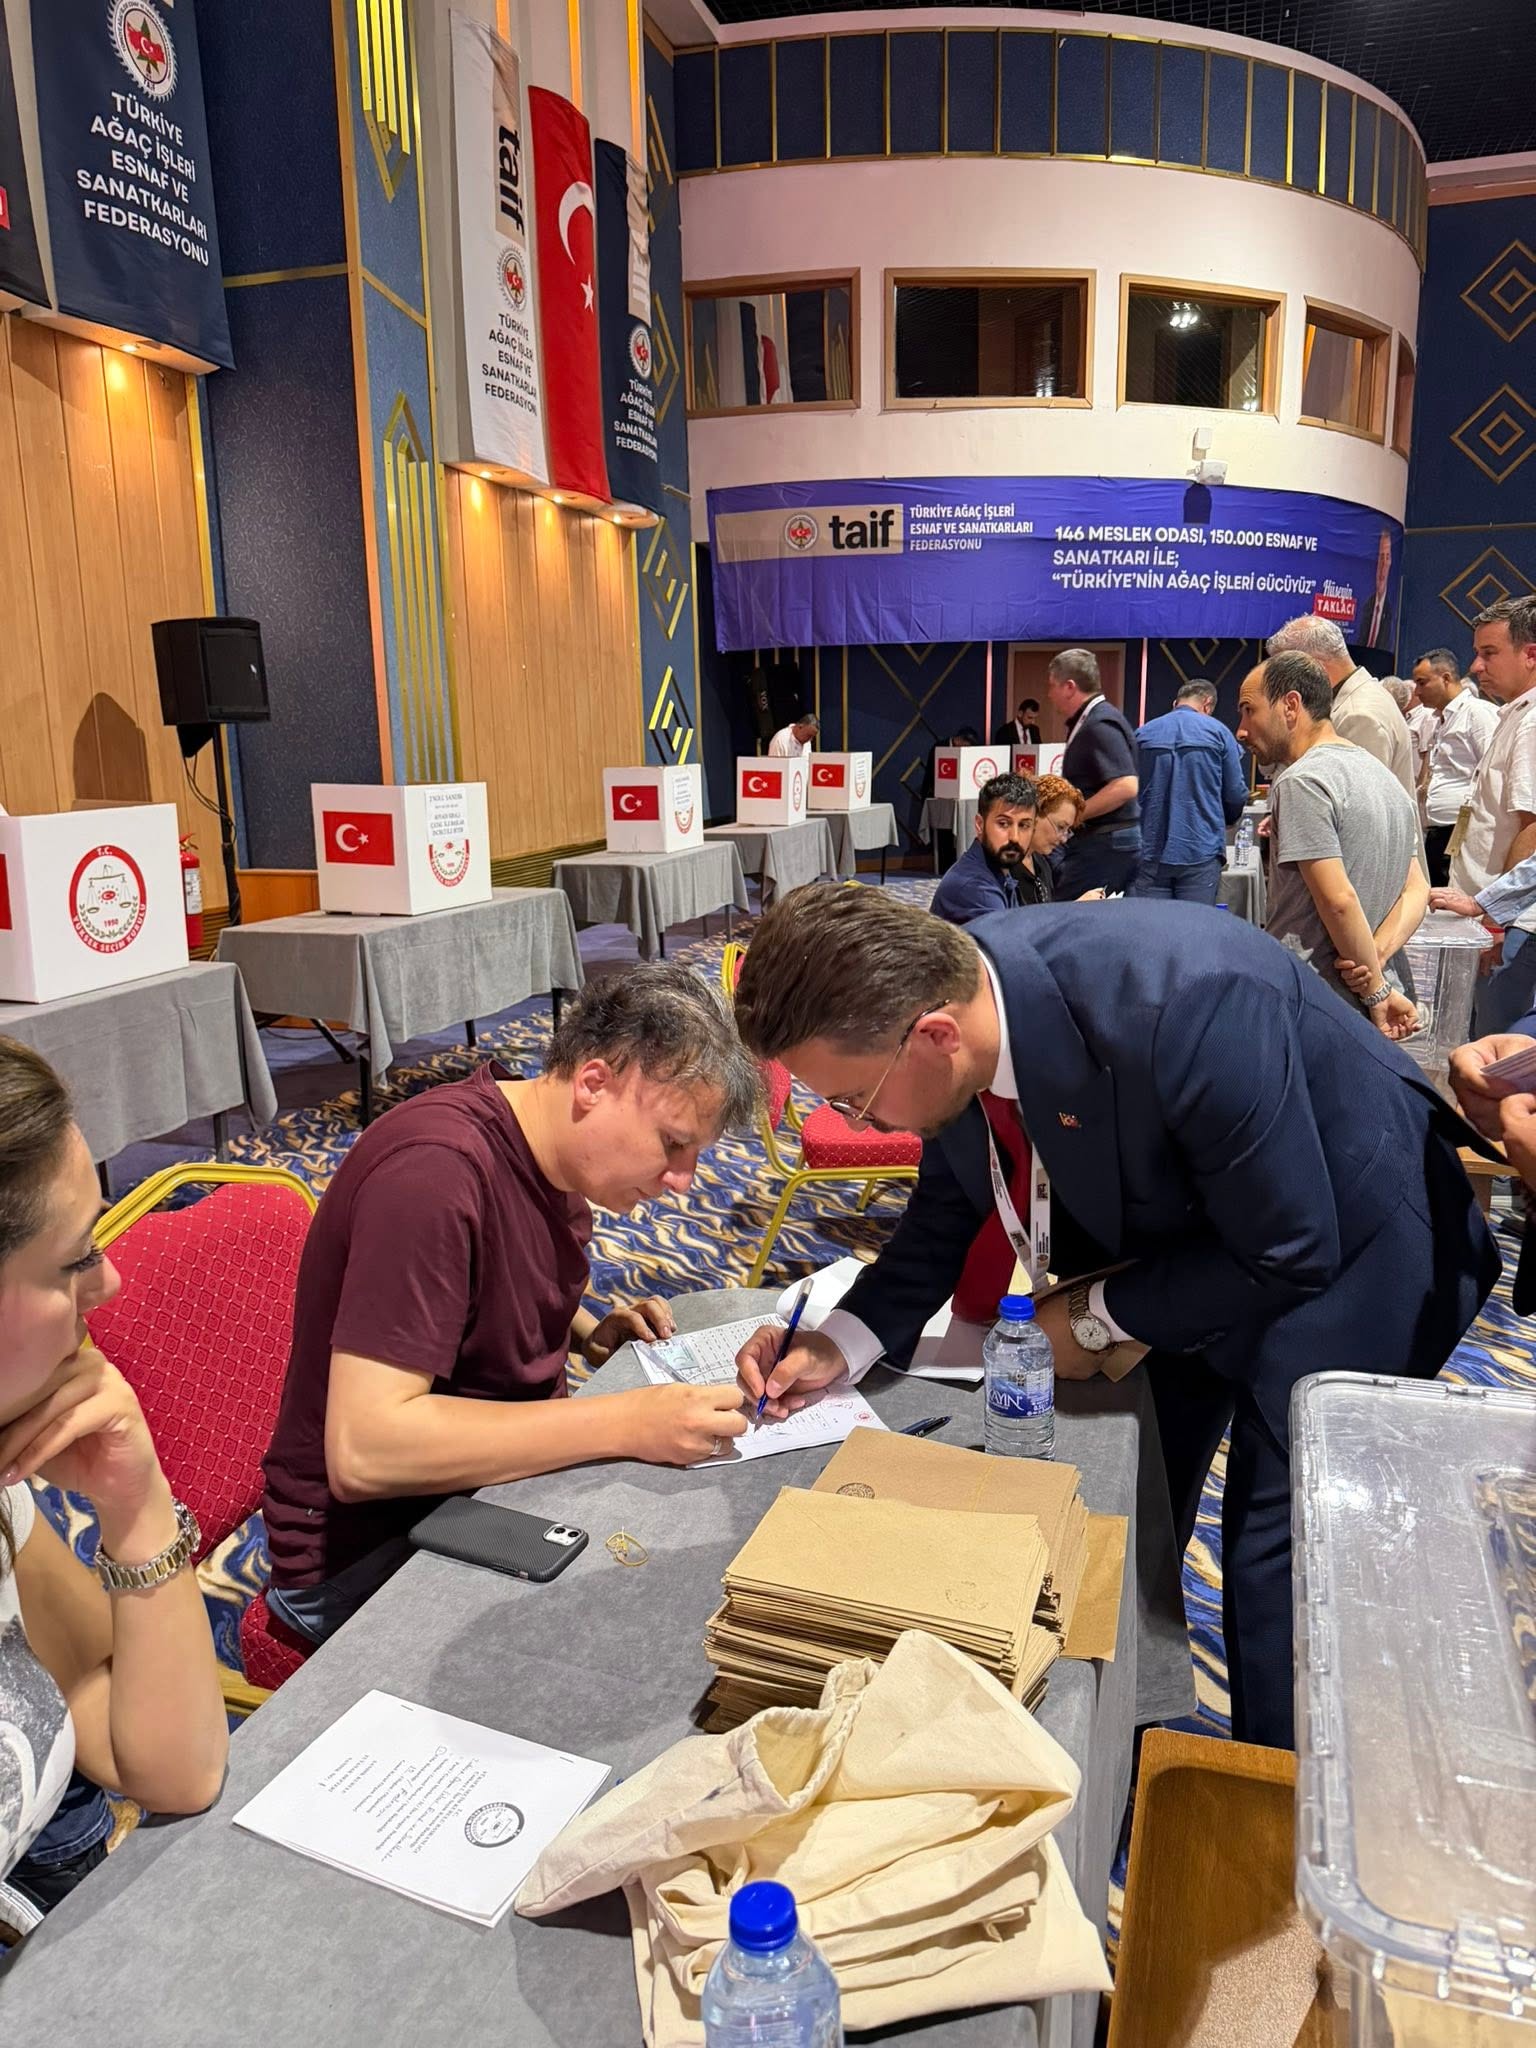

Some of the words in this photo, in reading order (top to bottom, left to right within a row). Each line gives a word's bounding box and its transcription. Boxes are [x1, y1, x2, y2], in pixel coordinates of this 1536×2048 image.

[111, 91, 184, 147] TÜRKİYE
[91, 114, 153, 159] AĞAÇ
[155, 136, 196, 183] İŞLERİ
[111, 149, 170, 190] ESNAF
[171, 176, 190, 204] VE
[499, 125, 525, 236] taif
[76, 168, 208, 242] SANATKARLARI
[83, 199, 209, 267] FEDERASYONU
[488, 329, 517, 354] AĞAÇ
[498, 350, 523, 371] ESNAF
[909, 503, 953, 519] TÜRKİYE
[954, 503, 982, 521] AĞAÇ
[983, 502, 1015, 520] İŞLERİ
[828, 509, 895, 550] taif
[910, 522, 943, 535] ESNAF
[943, 522, 957, 534] VE
[958, 521, 1033, 534] SANATKARLARI
[1055, 525, 1085, 541] 146
[1088, 526, 1153, 542] MESLEK
[1155, 527, 1207, 546] ODASI,
[1210, 529, 1264, 546] 150.000
[1265, 532, 1303, 550] ESNAF
[1304, 536, 1318, 551] VE
[910, 538, 982, 551] FEDERASYONU
[1053, 549, 1149, 566] SANATKARI
[1153, 546, 1179, 568] İLE;
[1166, 570, 1211, 594] AĞAÇ
[1213, 570, 1255, 594] İŞLERİ
[1317, 599, 1355, 615] TAKLACI
[97, 847, 113, 856] T.C.
